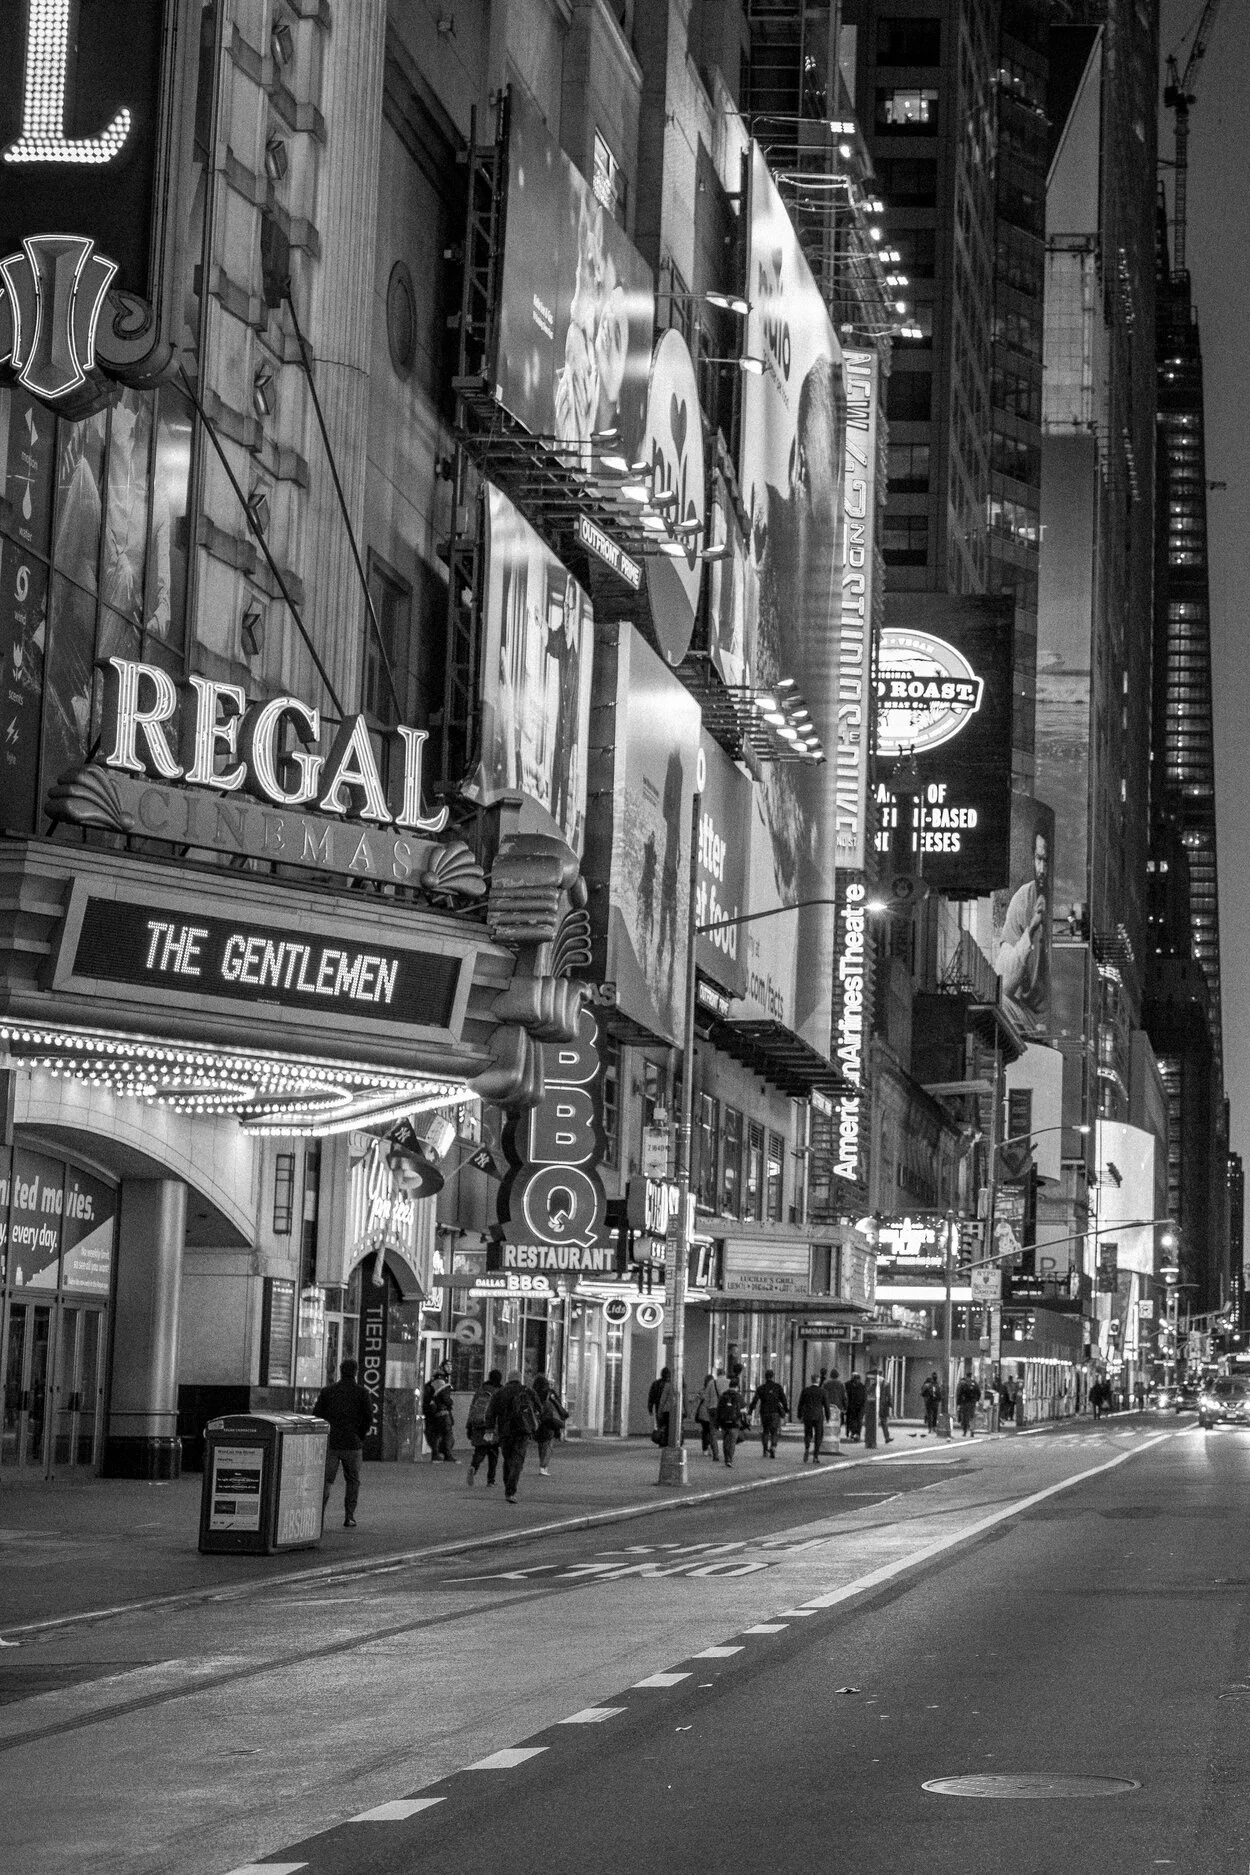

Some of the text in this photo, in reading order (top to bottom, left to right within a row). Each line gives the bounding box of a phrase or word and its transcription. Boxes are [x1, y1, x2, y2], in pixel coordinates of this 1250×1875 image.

[582, 519, 640, 586] OUTFRONT PRIME
[890, 681, 975, 702] ROAST.
[106, 656, 450, 833] REGAL
[927, 783, 947, 804] OF
[138, 788, 413, 880] CINEMAS
[147, 921, 399, 1004] THE GENTLEMEN
[12, 1224, 39, 1252] every
[39, 1222, 58, 1254] day.
[504, 1244, 615, 1271] RESTAURANT
[475, 1275, 550, 1291] DALLAS BBQ
[606, 1303, 626, 1315] Lids
[363, 1356, 381, 1398] BOX
